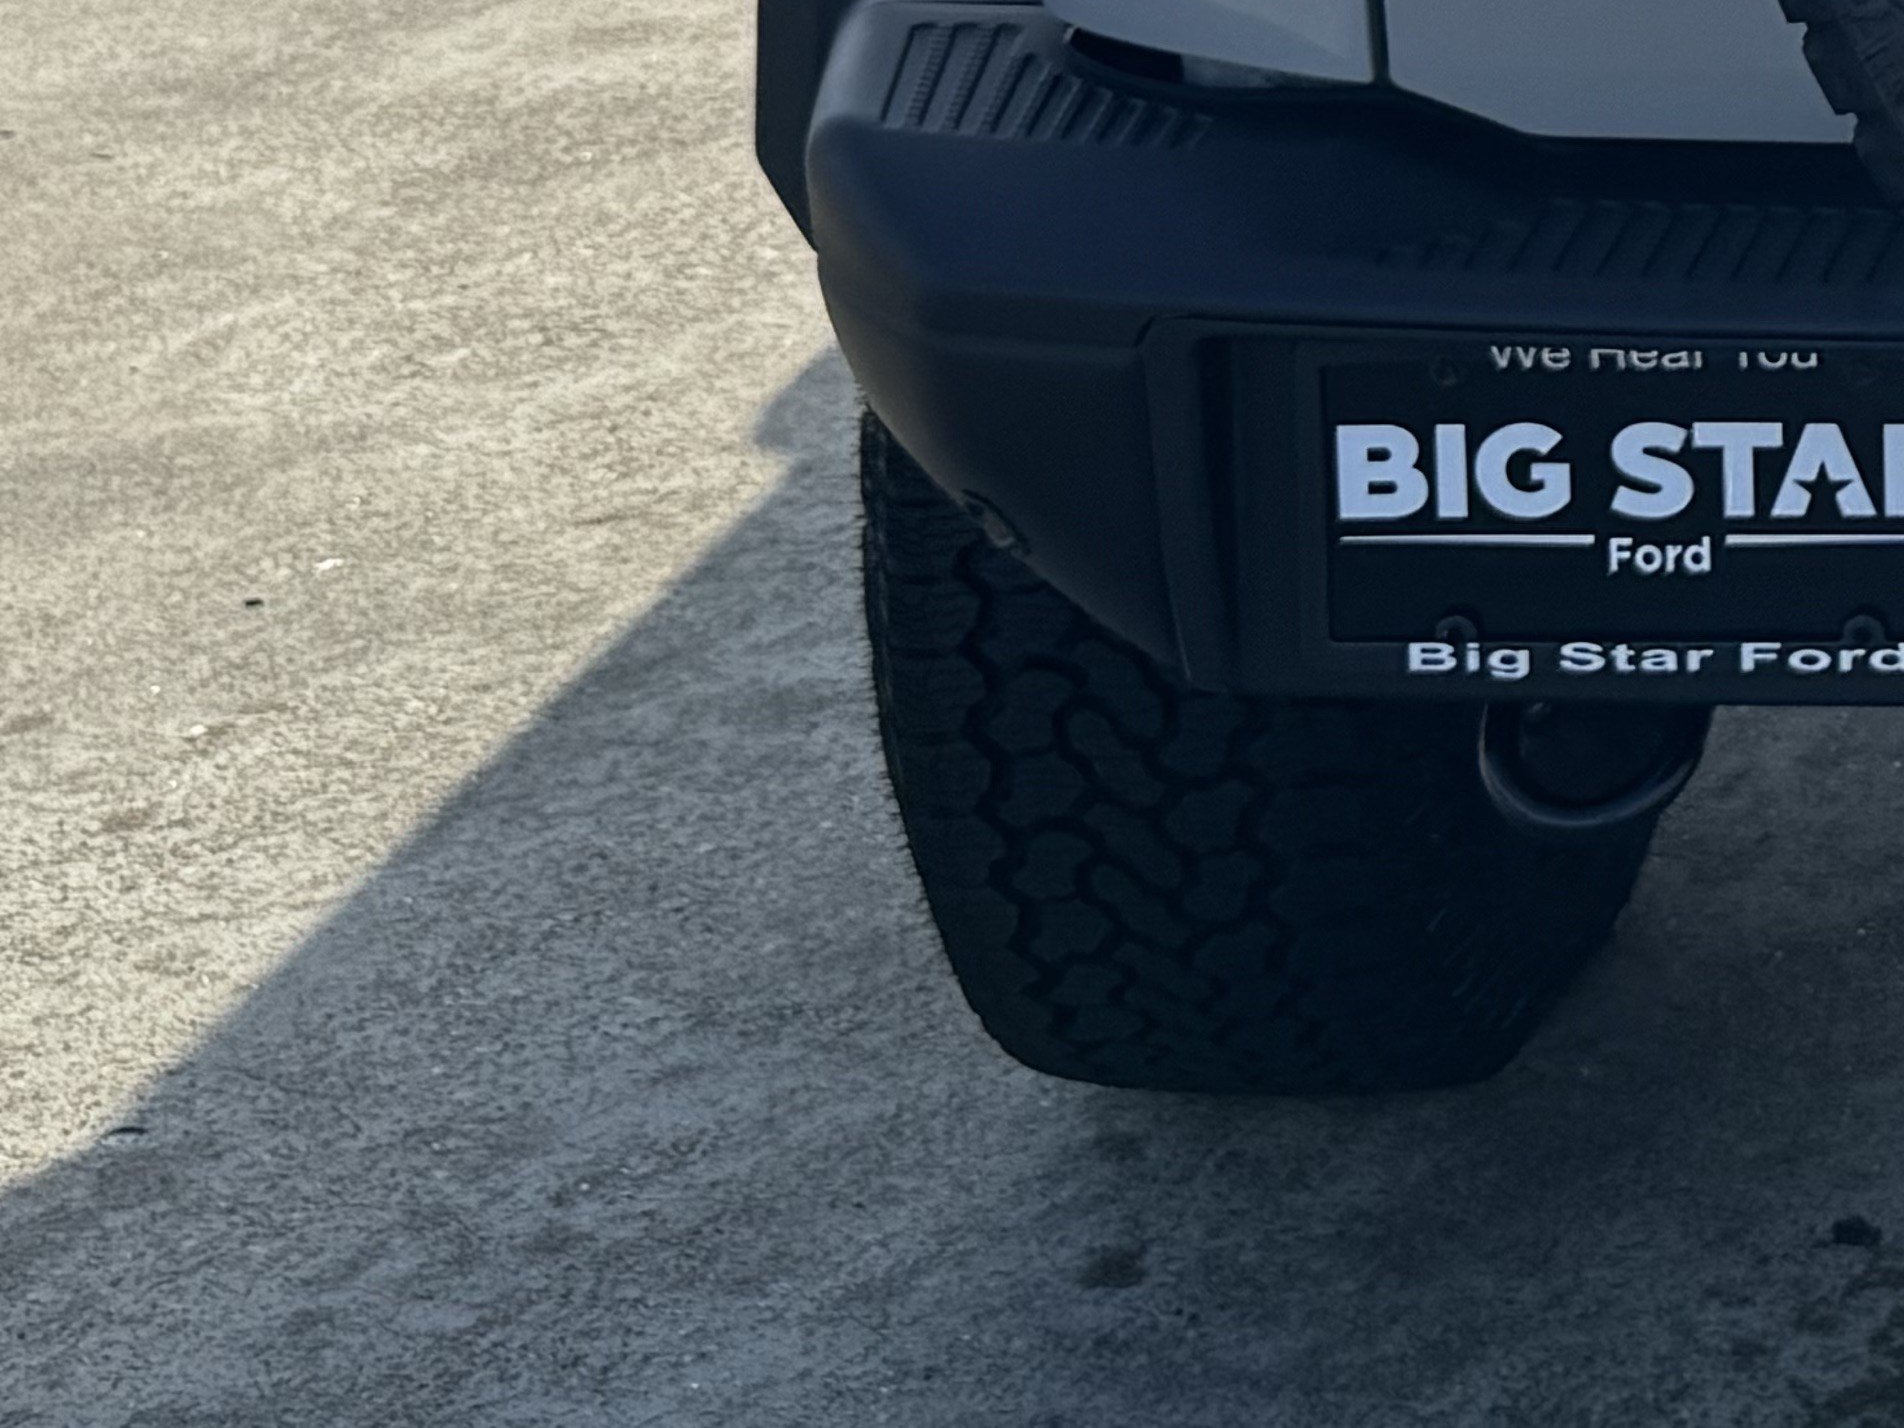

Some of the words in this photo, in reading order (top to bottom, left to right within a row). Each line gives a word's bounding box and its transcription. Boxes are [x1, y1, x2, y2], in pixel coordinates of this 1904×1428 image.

[1335, 422, 1573, 522] BIG
[1608, 536, 1712, 575] Ford
[1407, 641, 1532, 679] Big
[1557, 641, 1714, 675] Star
